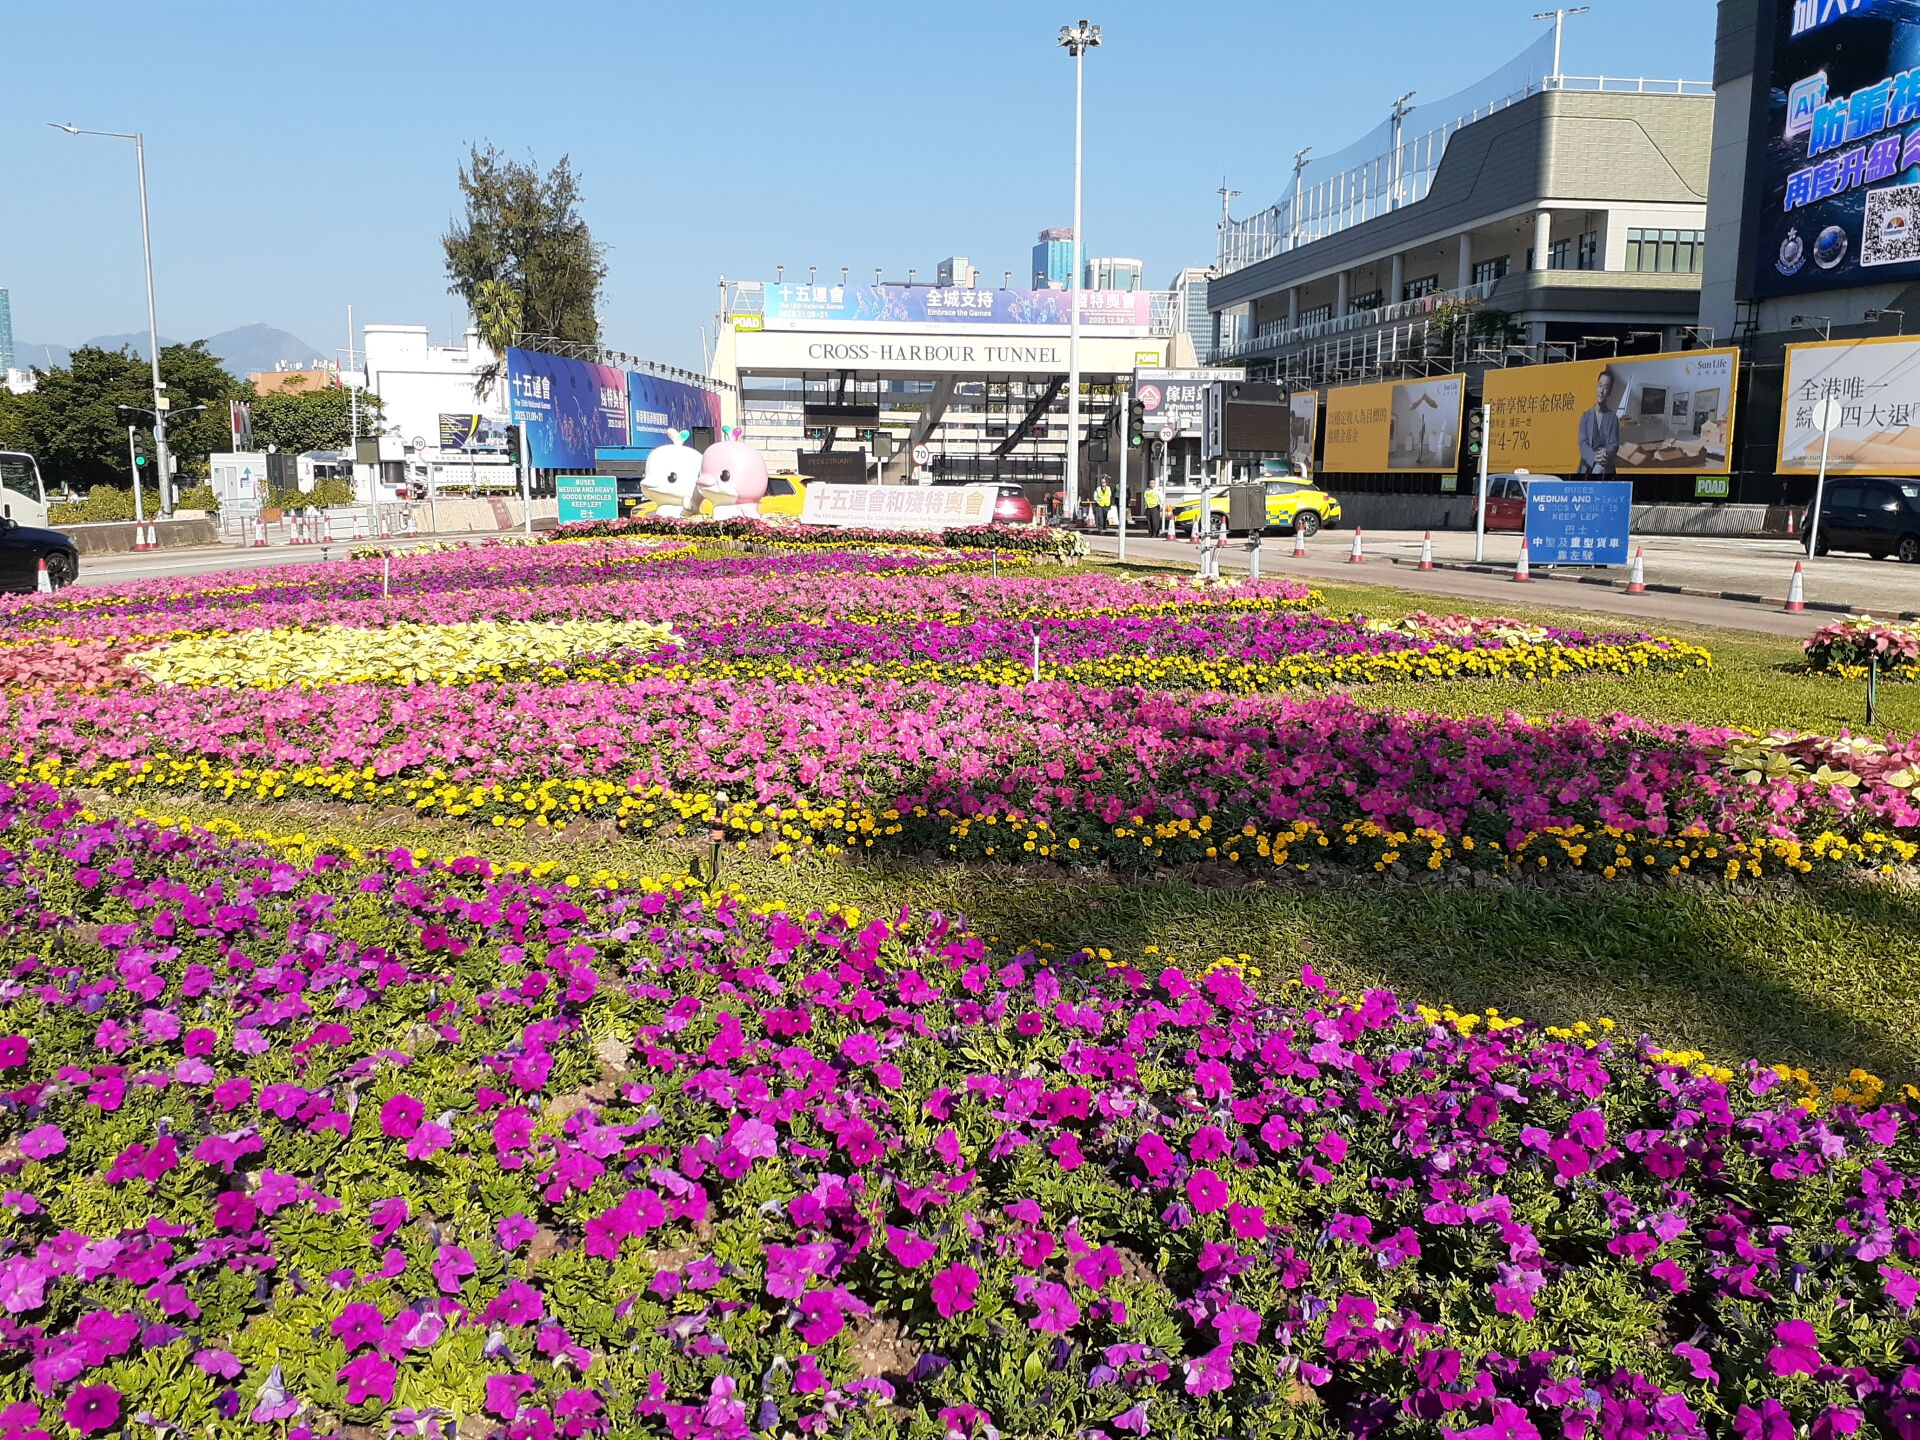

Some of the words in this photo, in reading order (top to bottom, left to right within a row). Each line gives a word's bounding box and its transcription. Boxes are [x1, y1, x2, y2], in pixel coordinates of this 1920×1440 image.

[1784, 134, 1901, 212] 再度升級
[778, 285, 844, 303] 十五運會
[926, 289, 994, 308] 全城支持
[927, 308, 956, 317] Embrace
[957, 309, 968, 317] the
[968, 309, 992, 317] Games
[808, 344, 976, 362] CROSS-HARBOUR
[984, 346, 1062, 363] TUNNEL
[1697, 361, 1712, 369] Sun
[1712, 359, 1727, 368] Life
[512, 372, 551, 400] 十五運會
[1798, 376, 1889, 401] 全港唯一
[1497, 430, 1531, 451] 4-7%
[915, 450, 926, 459] 70
[1697, 480, 1726, 493] POAD
[813, 488, 985, 515] 十五運會和殘特奧會
[1532, 495, 1568, 503] MEDIUM
[580, 509, 595, 518] 巴士
[1552, 513, 1577, 521] KEEP
[1532, 536, 1619, 548] 中型及重型貨車
[1557, 550, 1595, 561] 靠左駛
